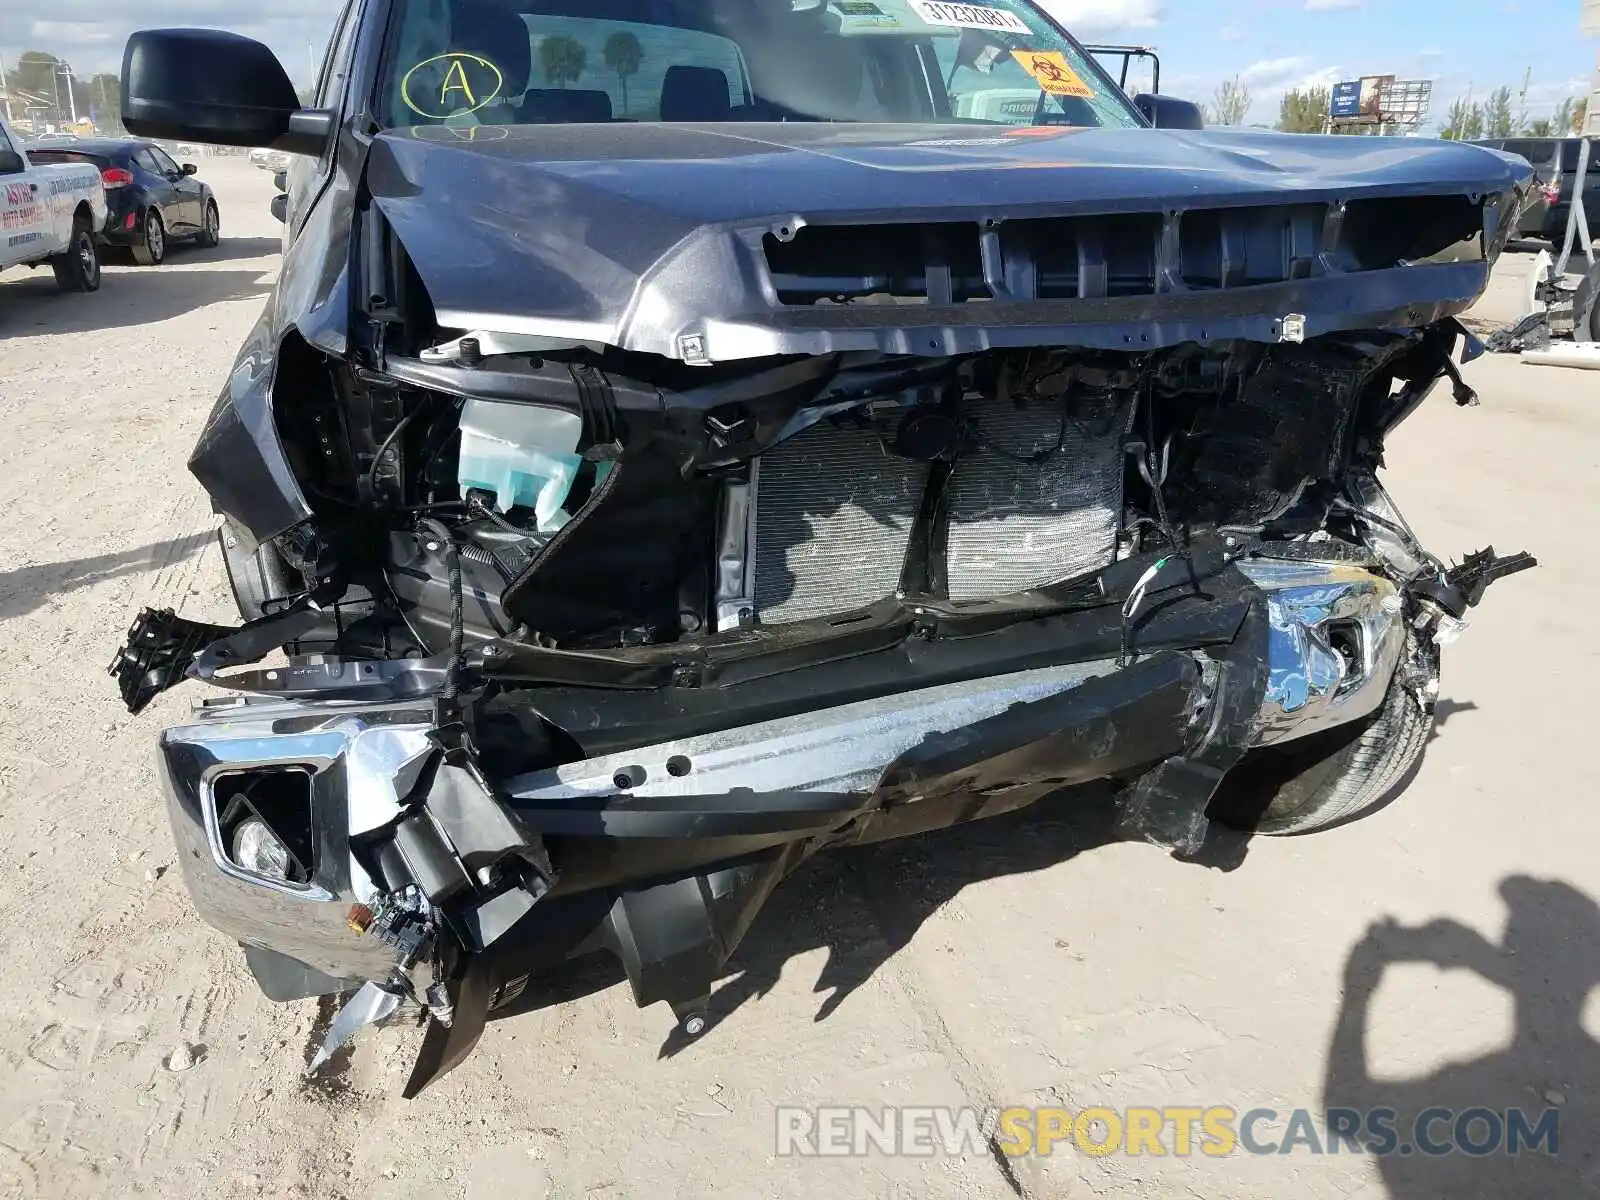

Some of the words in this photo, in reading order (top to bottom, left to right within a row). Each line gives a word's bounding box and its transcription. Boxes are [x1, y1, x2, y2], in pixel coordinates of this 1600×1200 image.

[922, 1, 1013, 28] 31232081
[440, 60, 476, 106] A
[1000, 103, 1051, 113] PRIORIY
